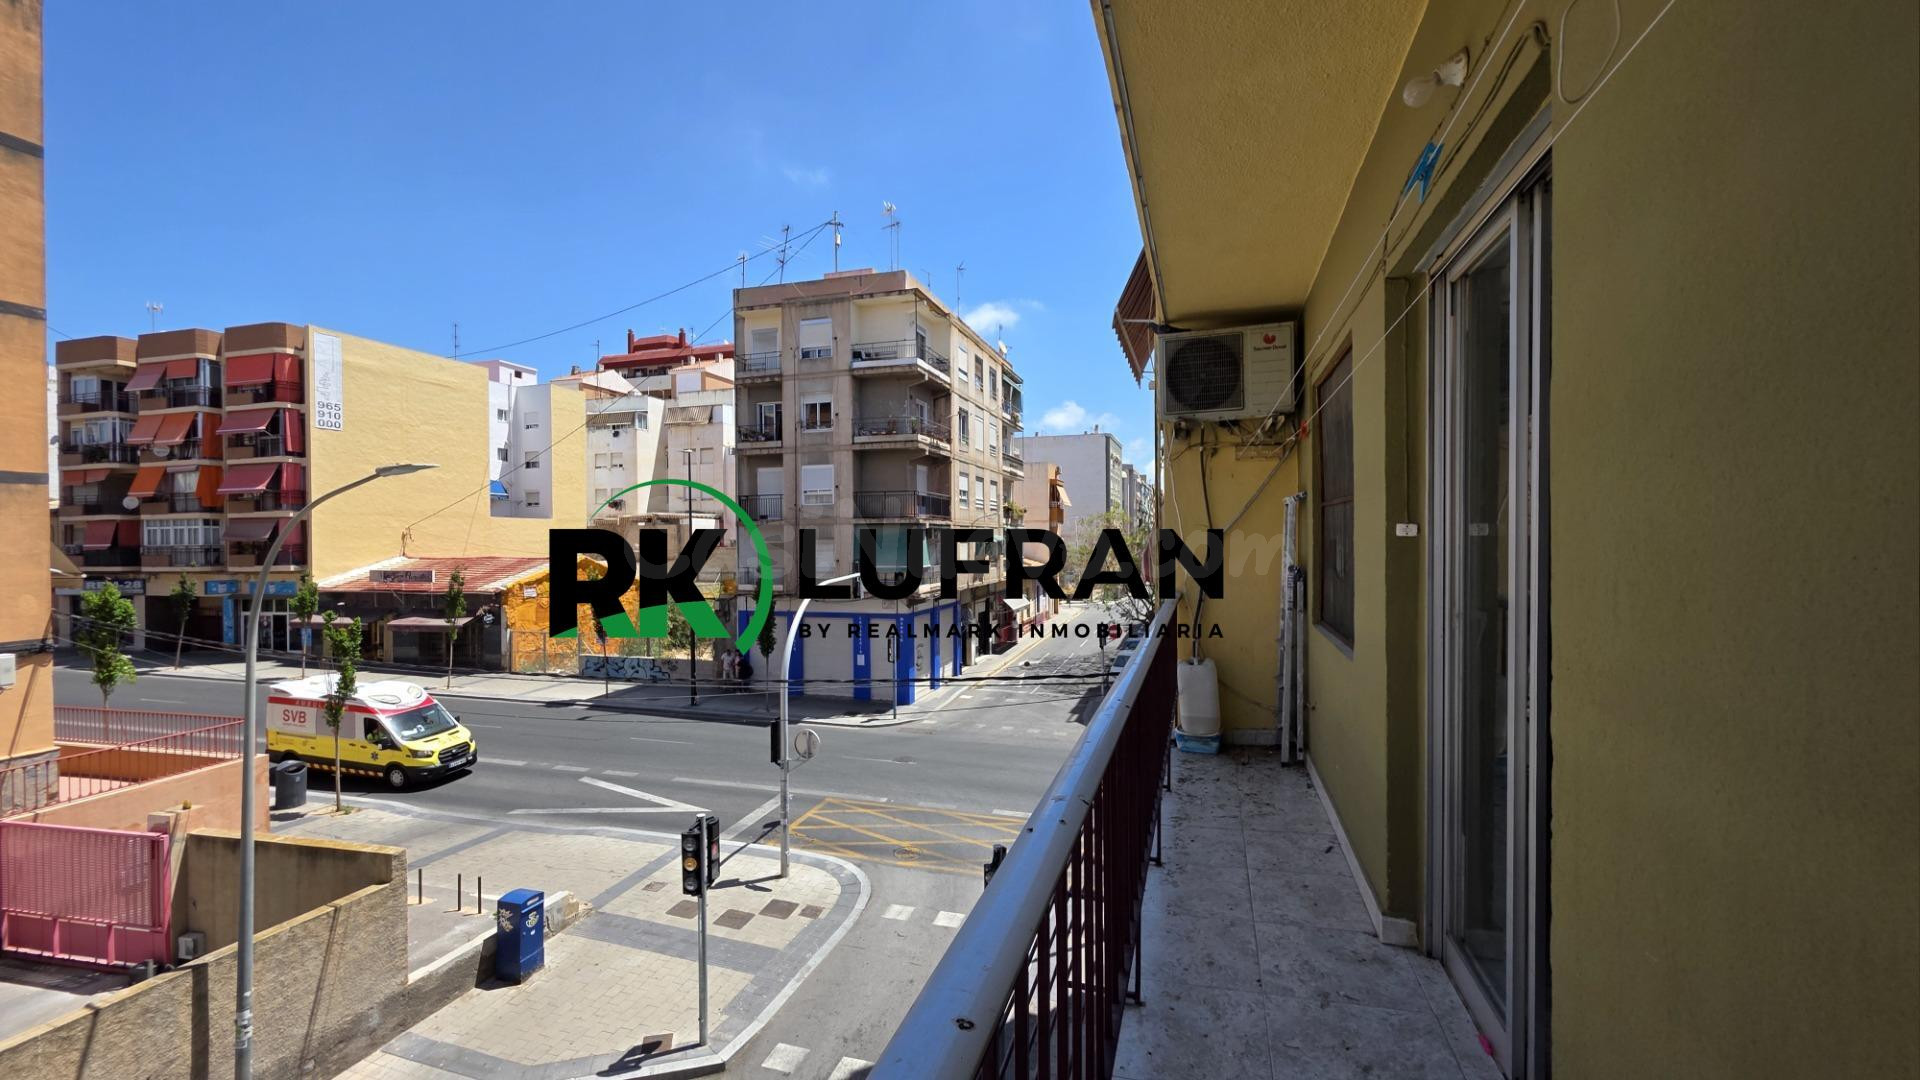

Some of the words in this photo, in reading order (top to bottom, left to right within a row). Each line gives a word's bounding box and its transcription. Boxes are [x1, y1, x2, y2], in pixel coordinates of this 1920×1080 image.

[317, 400, 341, 411] 965
[317, 410, 341, 420] 910
[318, 419, 341, 429] 000
[282, 709, 306, 723] SVB
